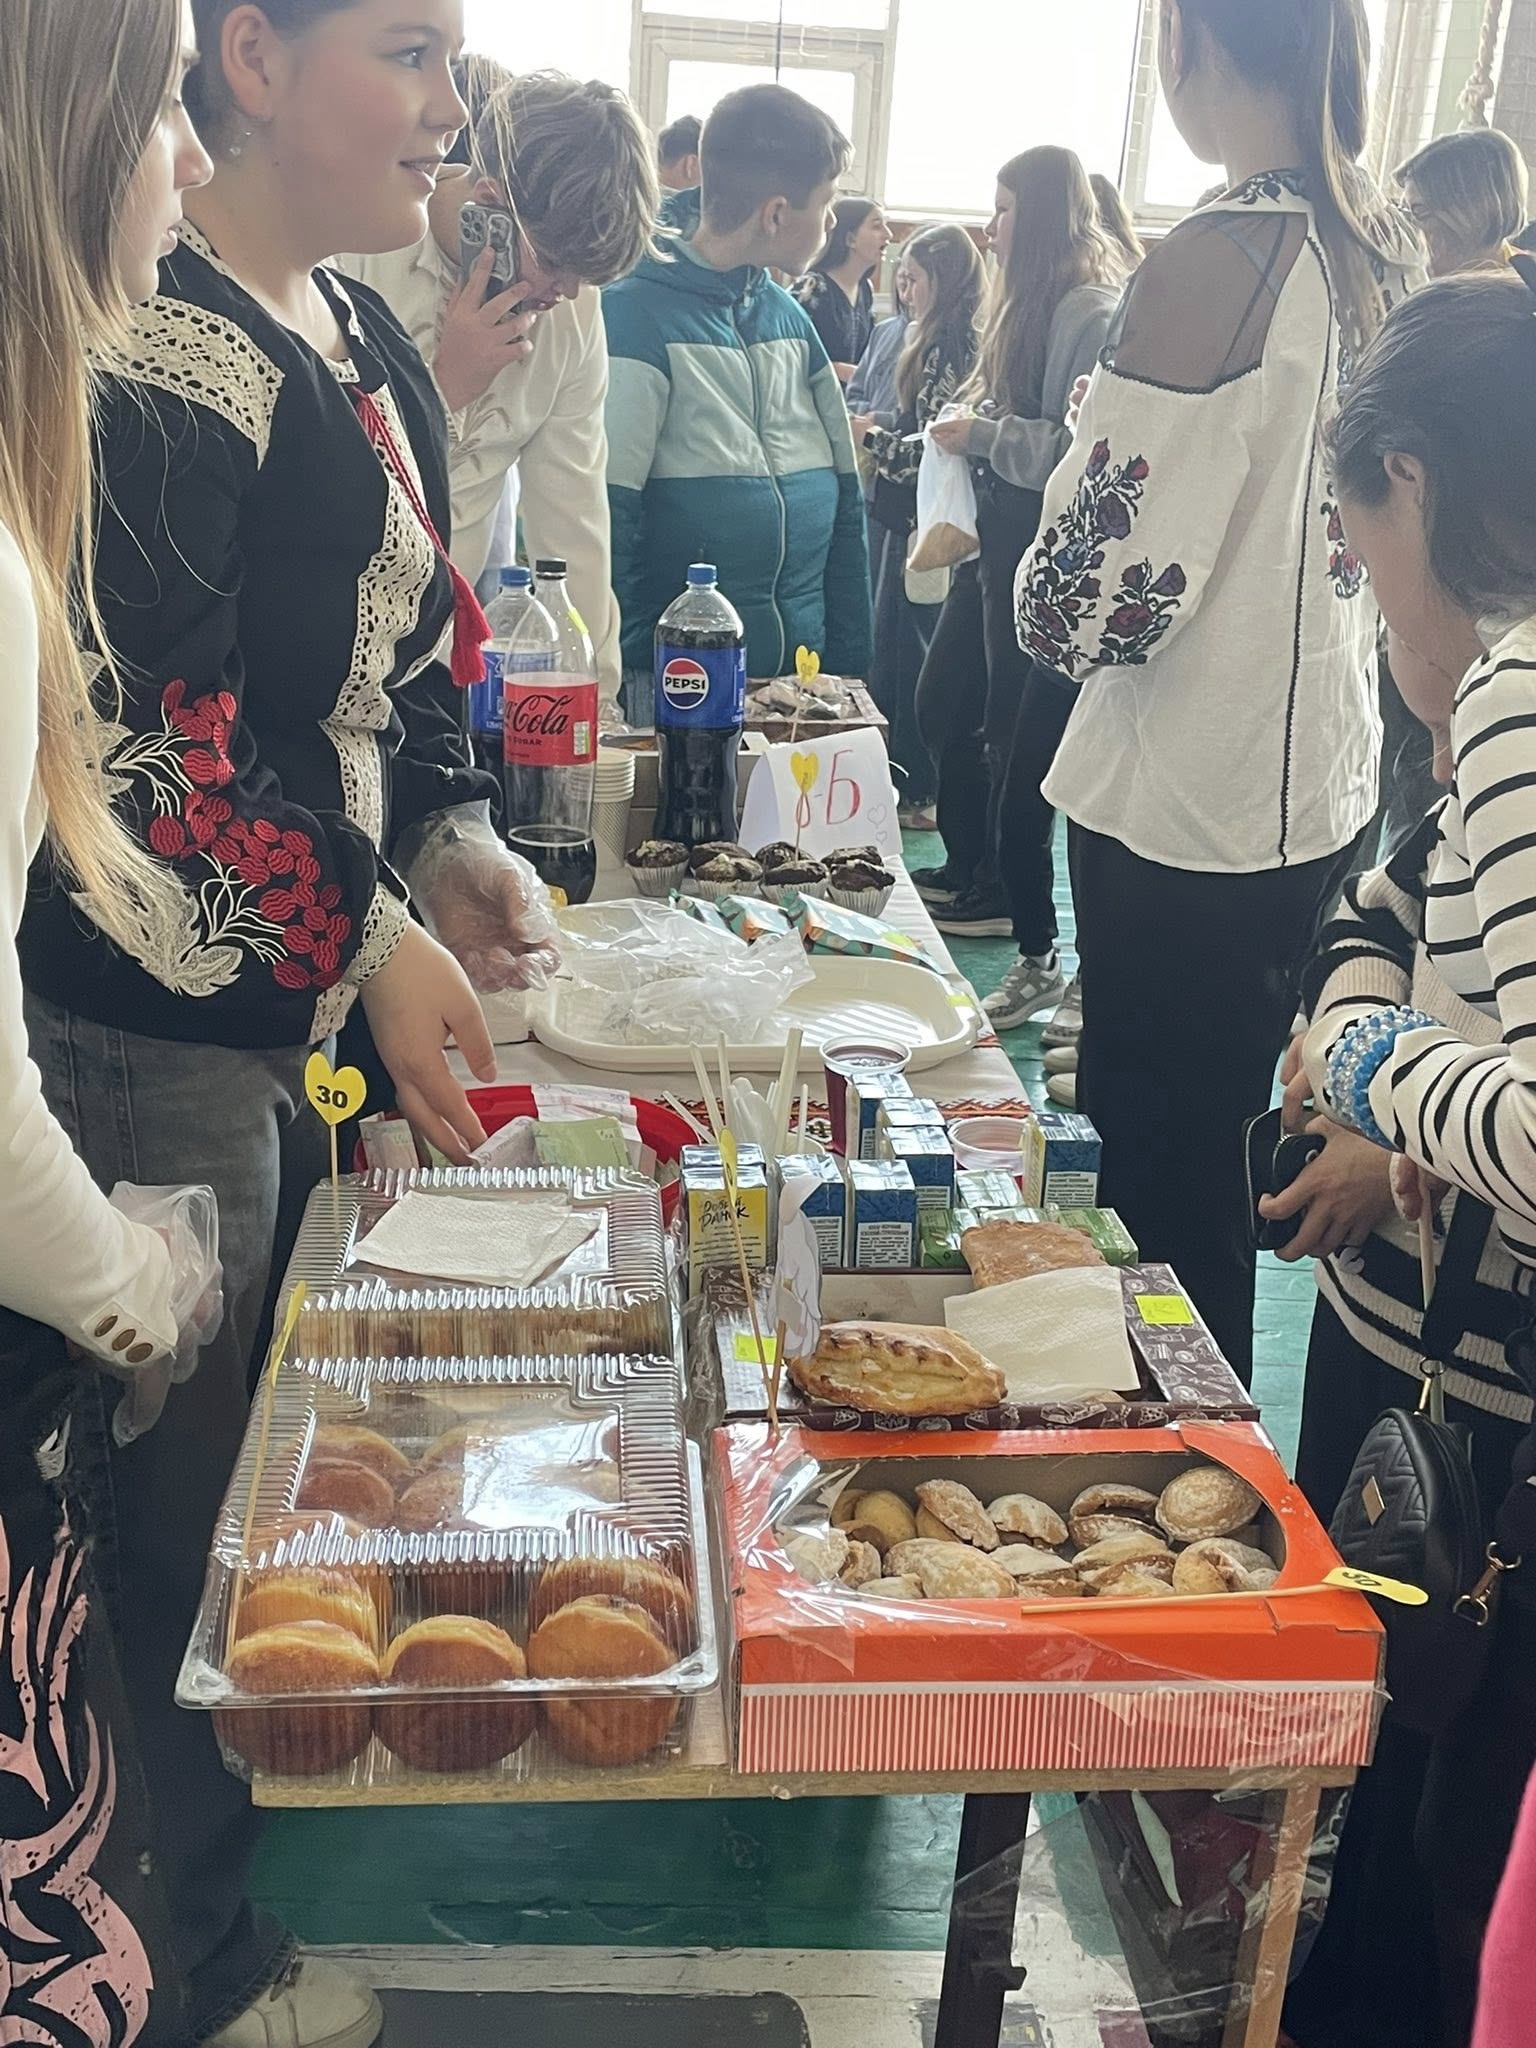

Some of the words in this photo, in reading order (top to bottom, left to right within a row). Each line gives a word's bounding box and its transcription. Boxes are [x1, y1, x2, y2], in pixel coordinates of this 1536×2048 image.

[665, 676, 706, 690] PEPSI
[315, 1084, 349, 1109] 30
[1341, 1571, 1382, 1587] 50
